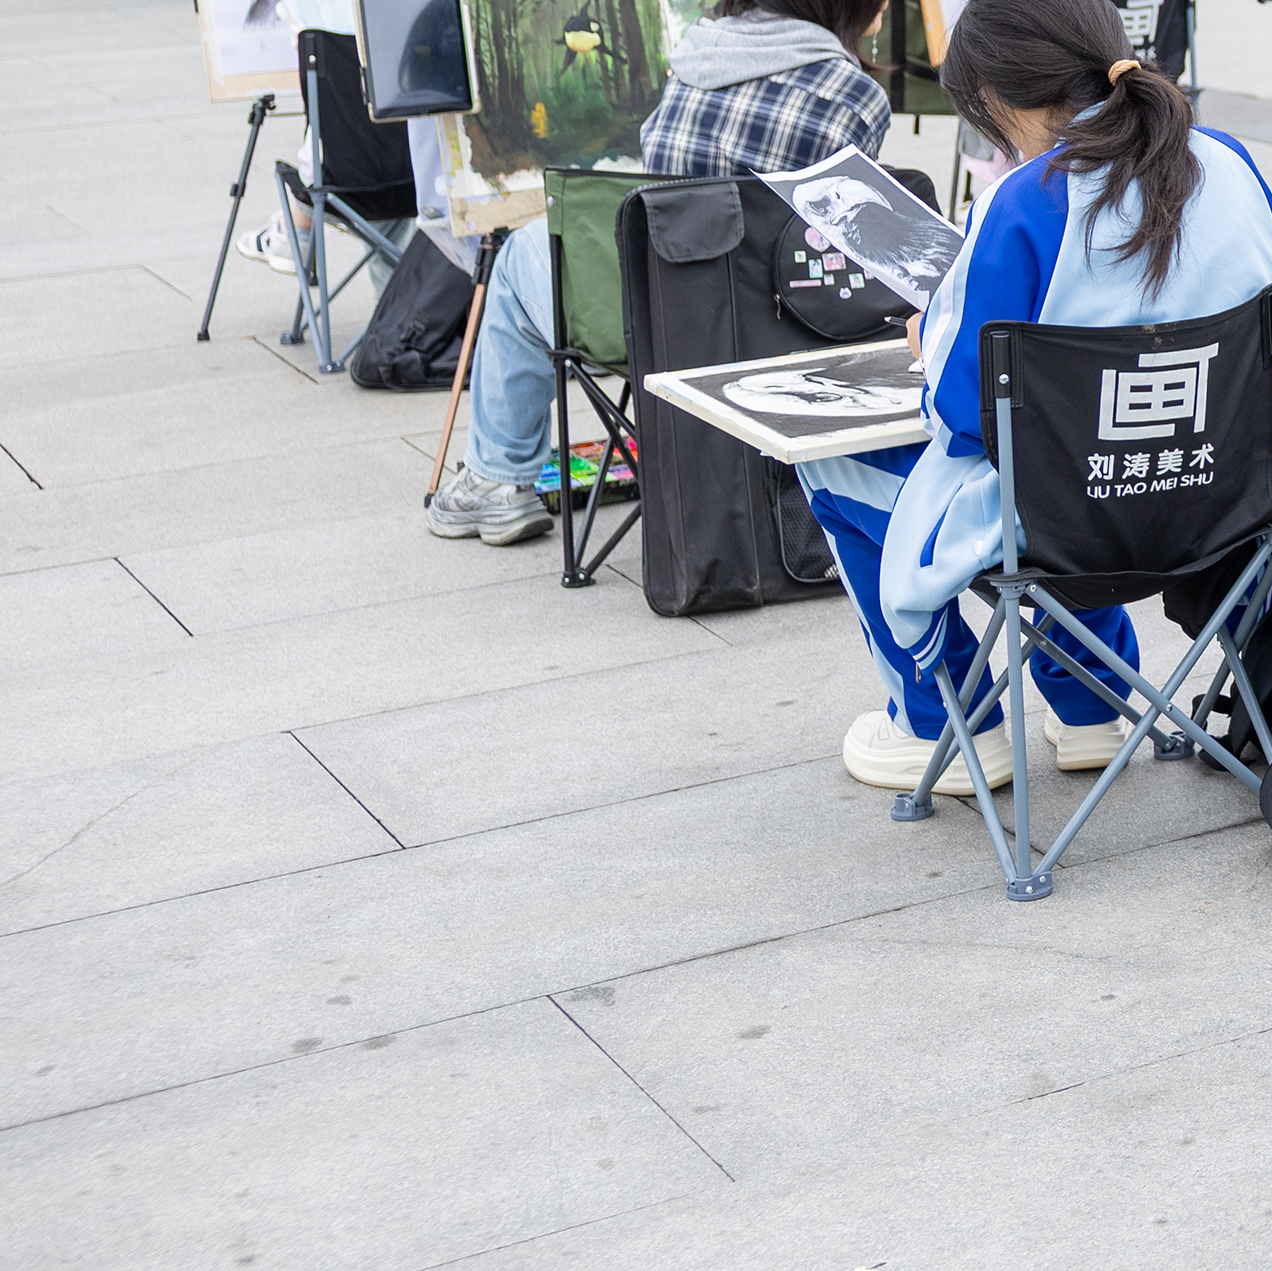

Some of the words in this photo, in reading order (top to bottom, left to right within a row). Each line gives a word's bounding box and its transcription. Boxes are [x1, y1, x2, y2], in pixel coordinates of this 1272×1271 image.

[1087, 443, 1215, 481] 刘涛美术
[1086, 485, 1111, 499] LIU
[1114, 481, 1148, 497] TAO
[1150, 476, 1178, 493] MEI
[1180, 471, 1215, 488] SHU
